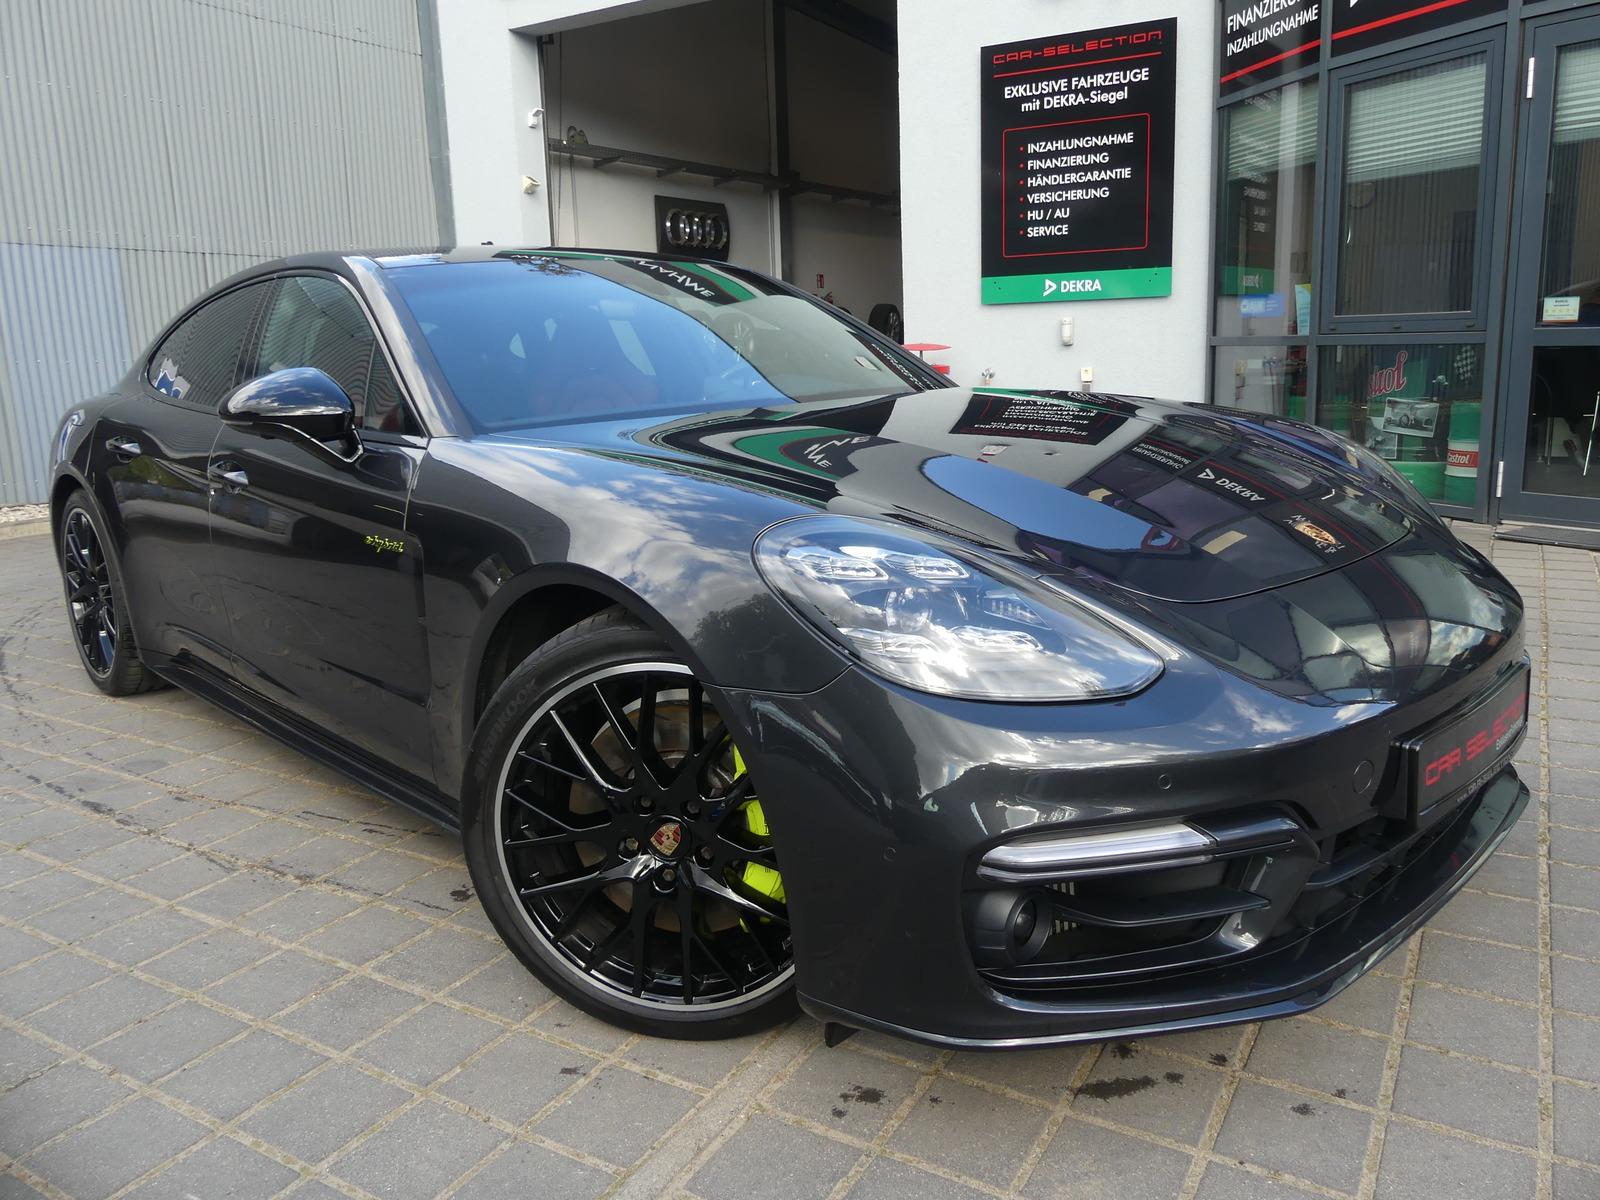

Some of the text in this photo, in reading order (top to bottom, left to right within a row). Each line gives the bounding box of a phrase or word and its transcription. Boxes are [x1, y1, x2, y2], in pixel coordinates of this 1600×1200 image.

[1227, 0, 1301, 34] FINANZIER
[1226, 4, 1319, 57] INZAHLUNGNAHME
[992, 30, 1162, 65] CAR-SELECTION
[1004, 67, 1150, 99] EXKLUSIVE FAHRZEUGE
[1021, 87, 1128, 112] mit DEKRA-Siegel
[1027, 132, 1134, 154] INZAHLUNGNAHME
[1027, 152, 1110, 170] FINANZIERUNG
[1027, 167, 1132, 187] HÄNDLERGARANTIE
[1027, 187, 1110, 204] VERSICHERUNG
[1027, 210, 1044, 221] HU
[1053, 207, 1070, 219] AU
[1027, 224, 1069, 237] SERVICE
[1060, 278, 1102, 293] DEKRA
[1424, 746, 1461, 787] CAR
